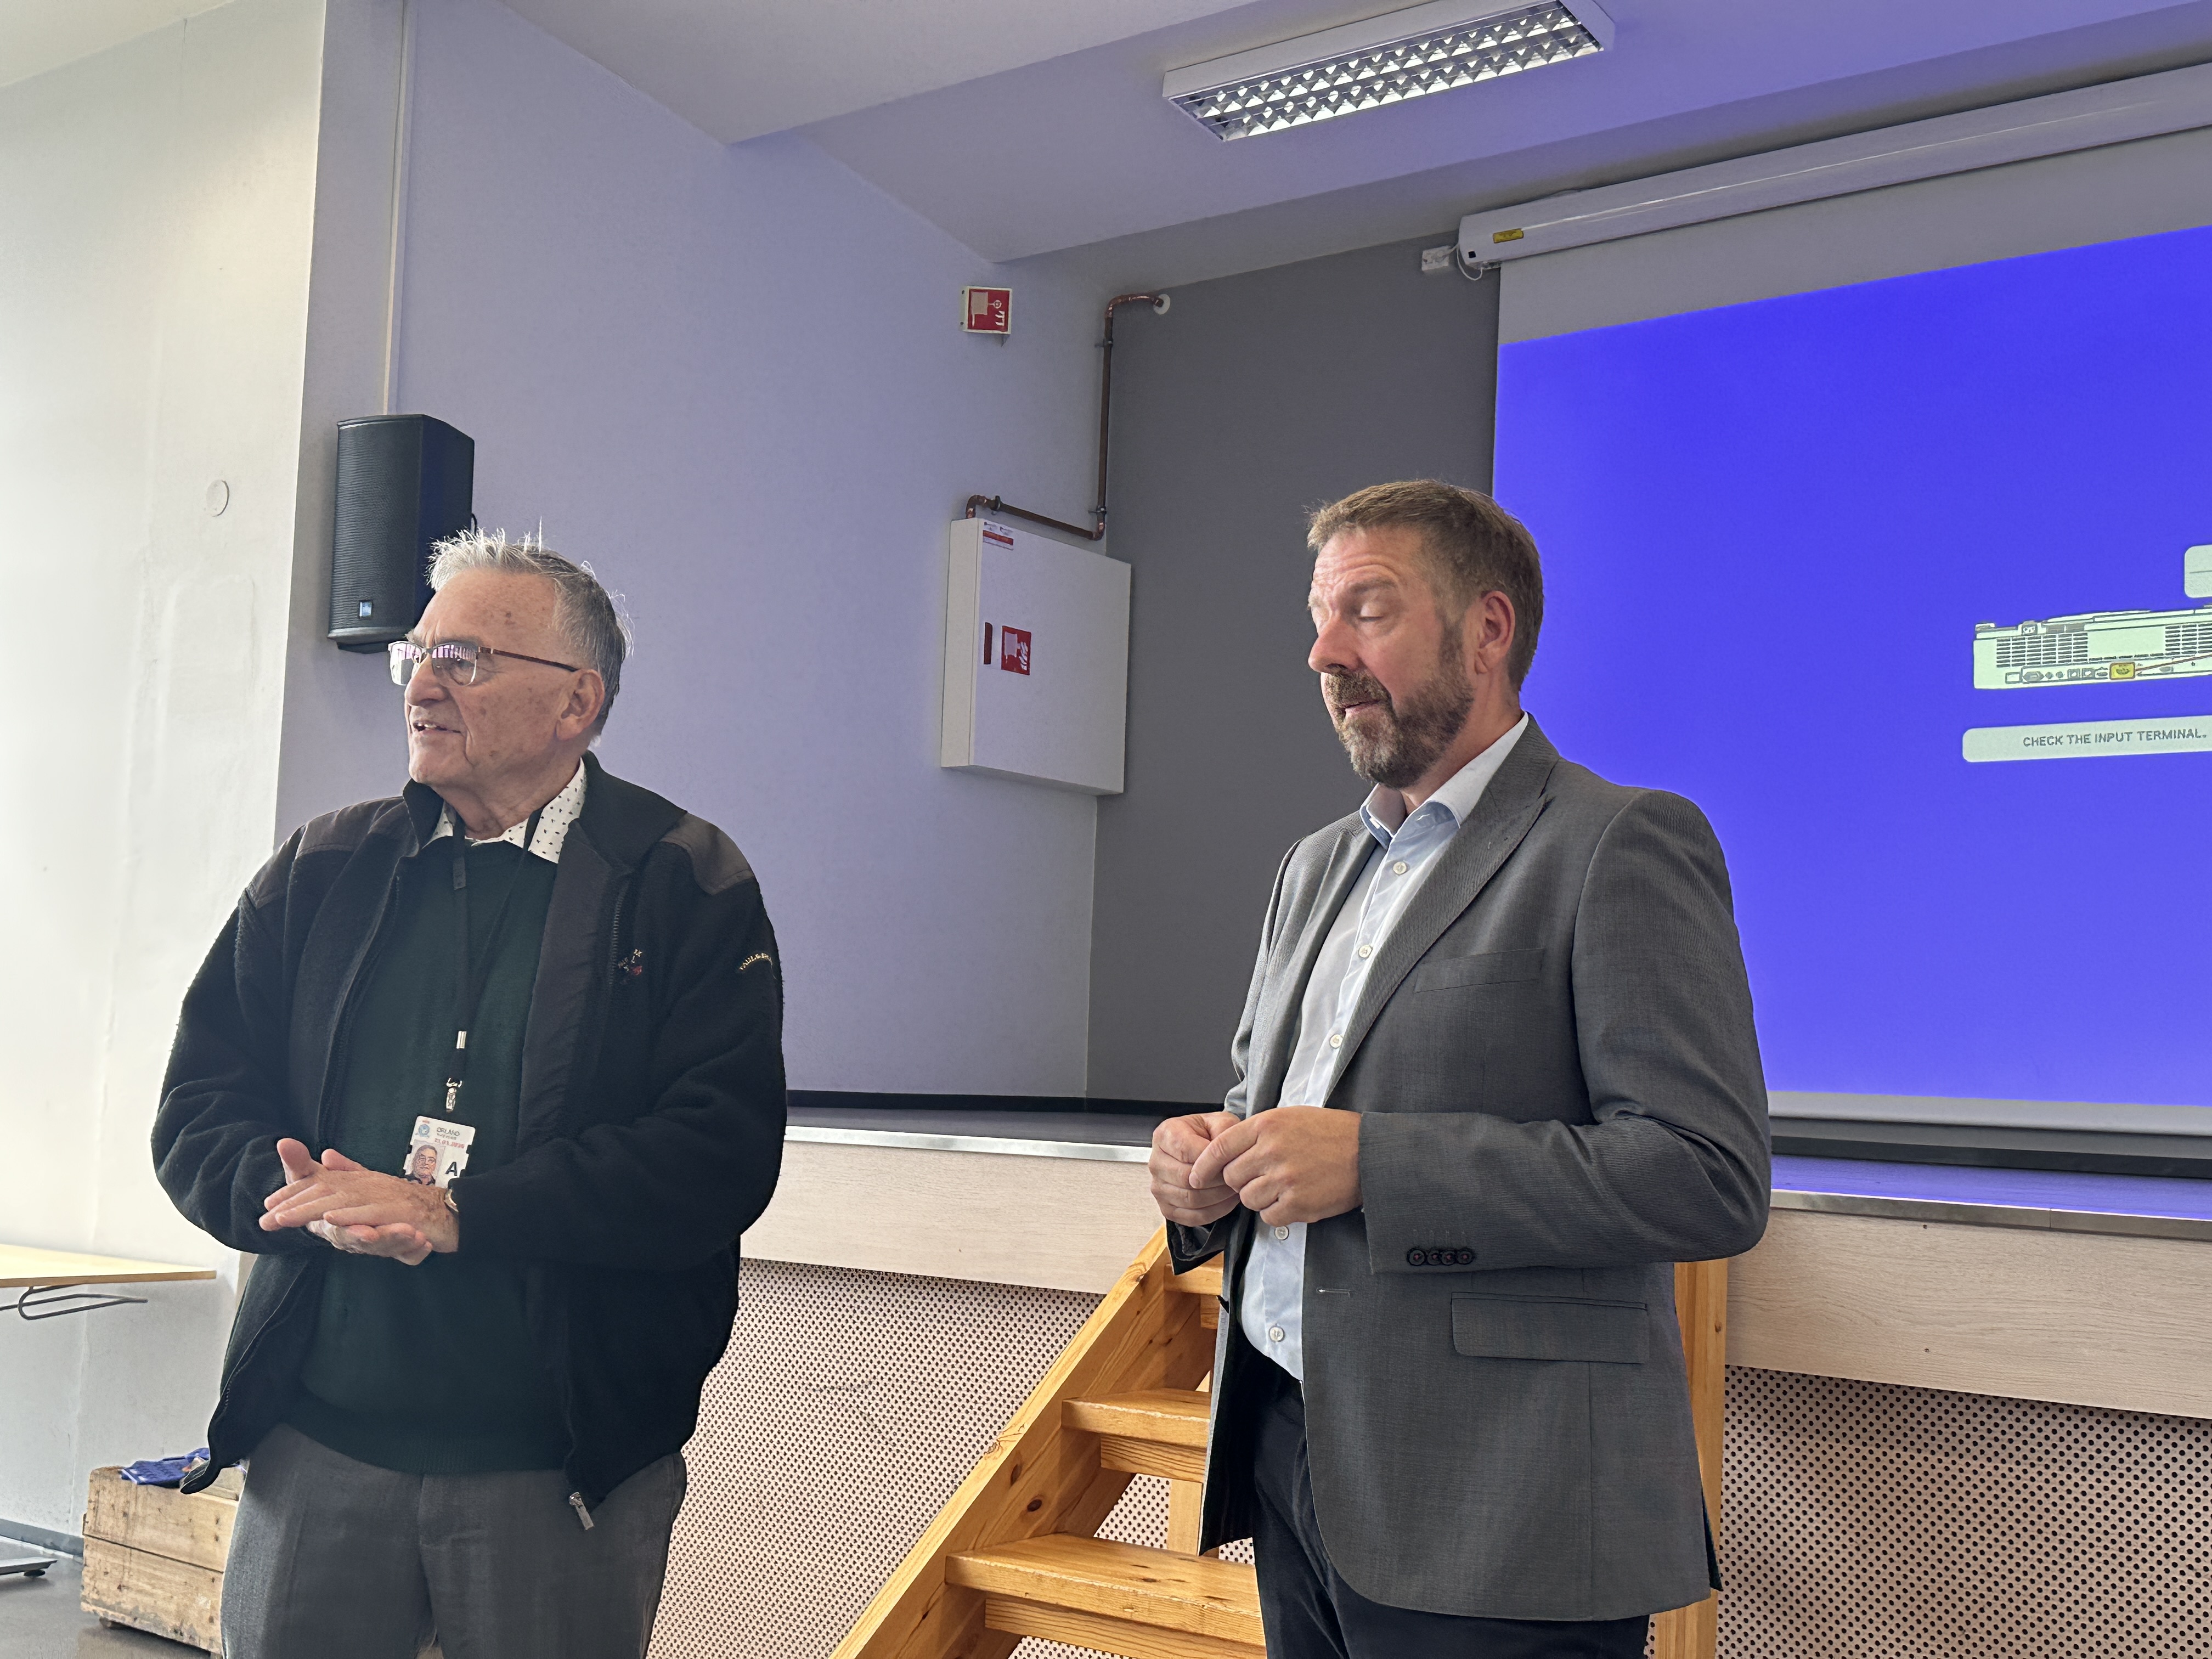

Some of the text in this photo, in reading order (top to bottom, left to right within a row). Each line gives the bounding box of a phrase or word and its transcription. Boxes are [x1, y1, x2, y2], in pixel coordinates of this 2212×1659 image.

[2023, 729, 2207, 747] CHECK THE INPUT TERMINAL.
[445, 1161, 458, 1176] A
